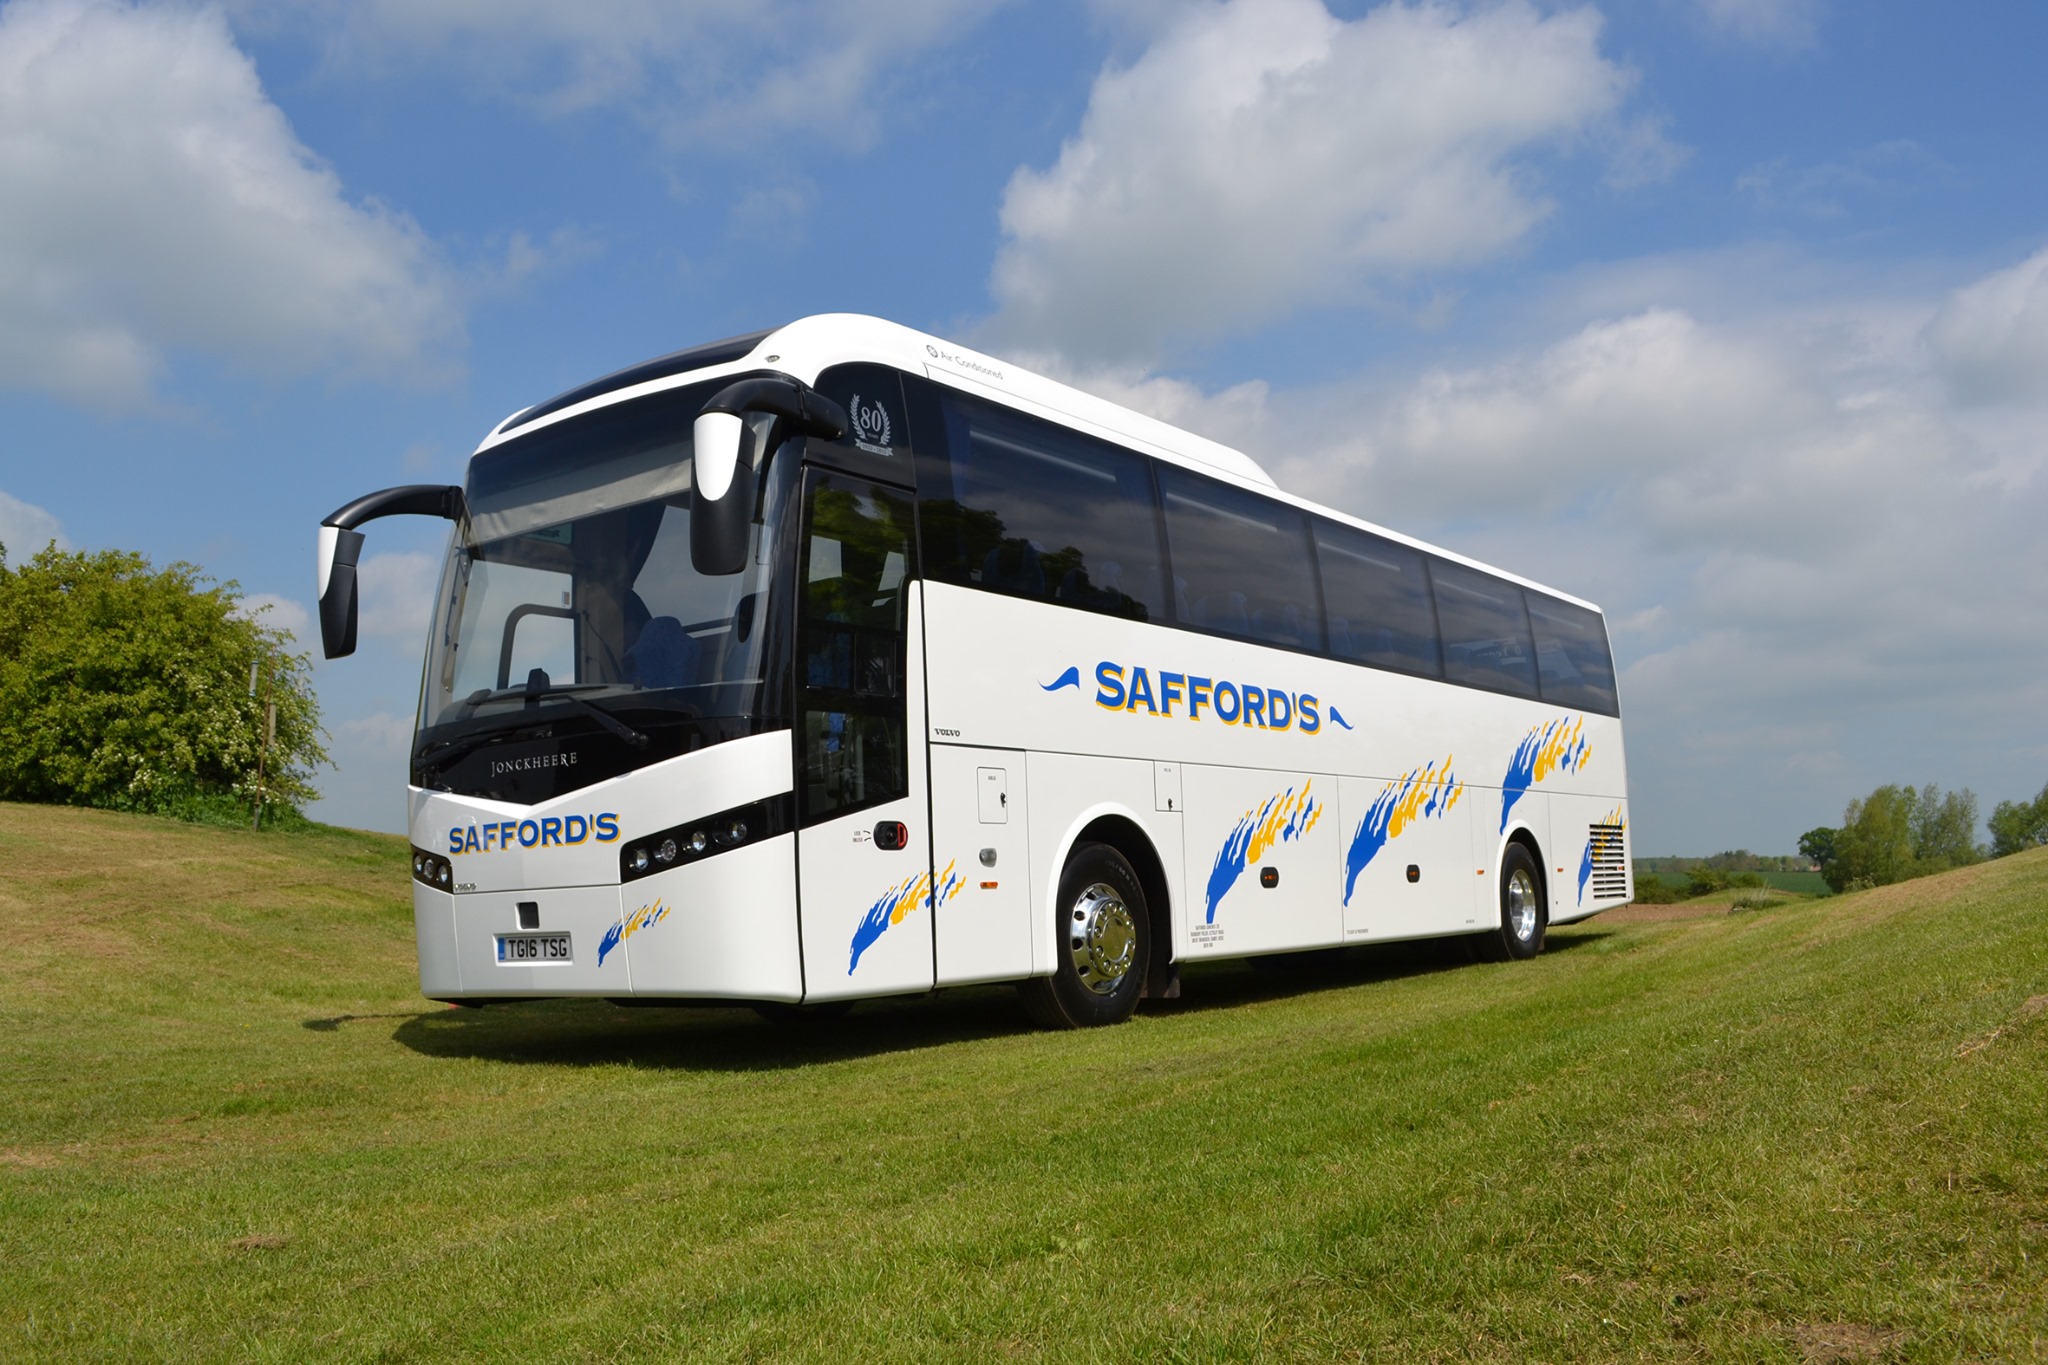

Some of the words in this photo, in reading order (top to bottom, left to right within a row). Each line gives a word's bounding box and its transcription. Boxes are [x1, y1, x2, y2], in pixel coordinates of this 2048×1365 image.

[860, 406, 882, 432] 80
[1095, 661, 1321, 736] SAFFORD'S
[934, 727, 961, 738] VOLVO
[491, 752, 578, 777] JONCKHEERE
[449, 812, 621, 856] SAFFORD'S
[508, 939, 538, 958] TG16
[541, 938, 567, 957] TSG
